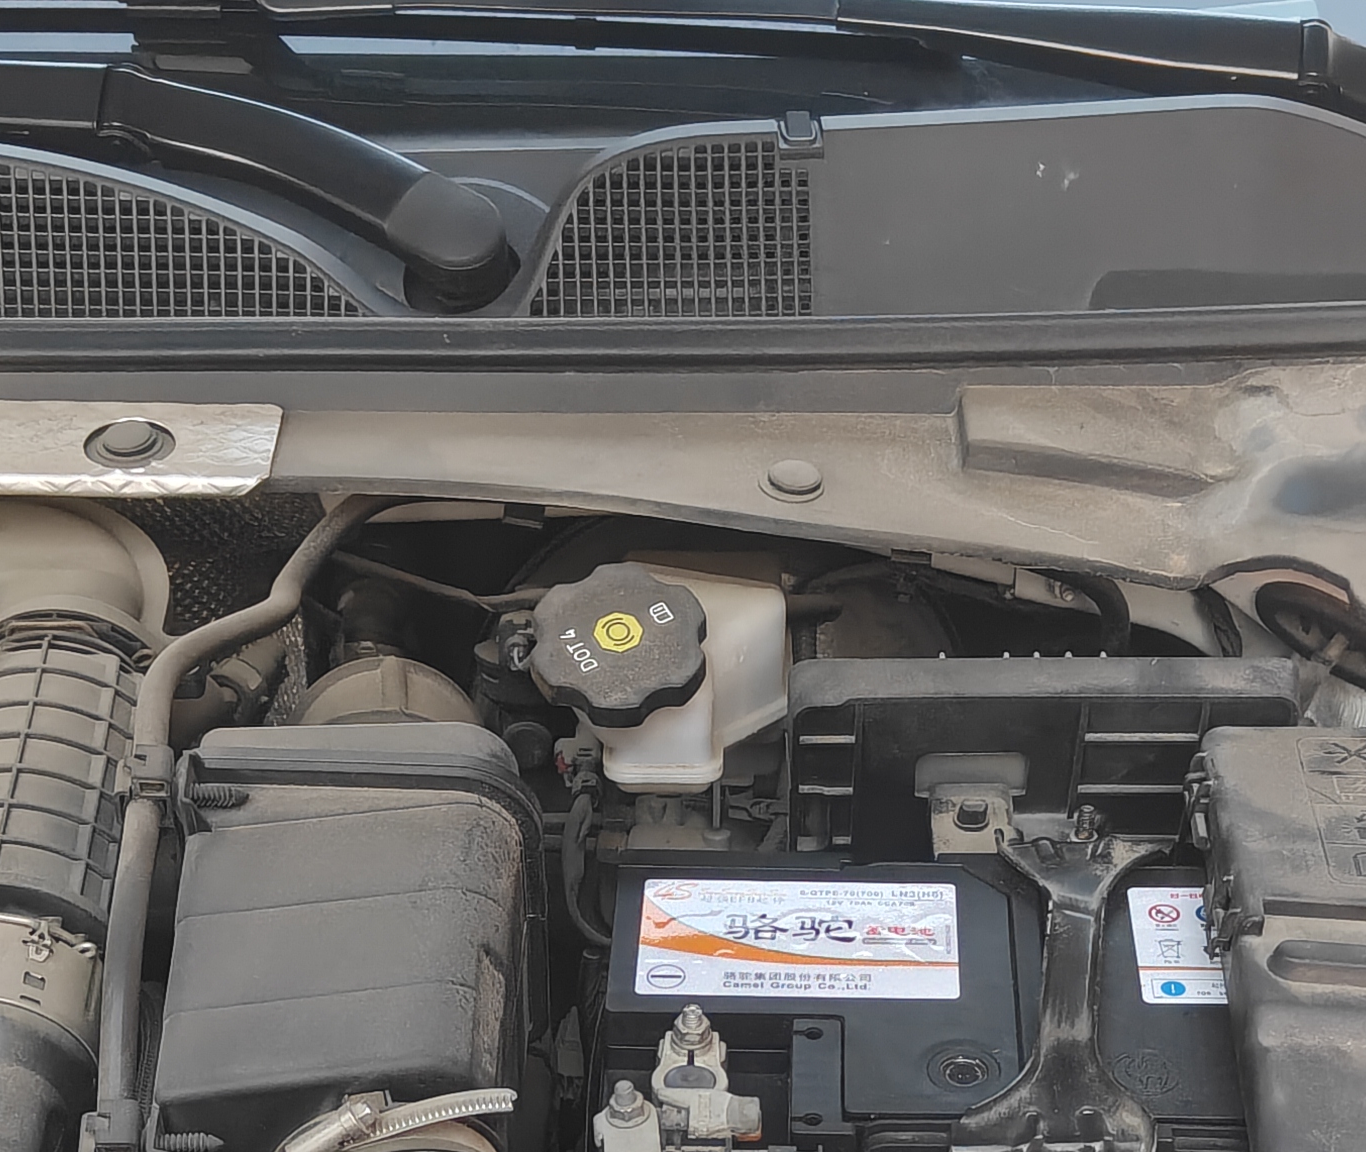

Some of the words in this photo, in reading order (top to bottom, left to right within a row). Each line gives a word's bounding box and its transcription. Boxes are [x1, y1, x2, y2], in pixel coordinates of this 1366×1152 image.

[560, 629, 576, 640] 4
[566, 642, 598, 673] DOT
[724, 914, 857, 943] 骆驼
[723, 981, 764, 989] Camel
[770, 981, 811, 991] Group
